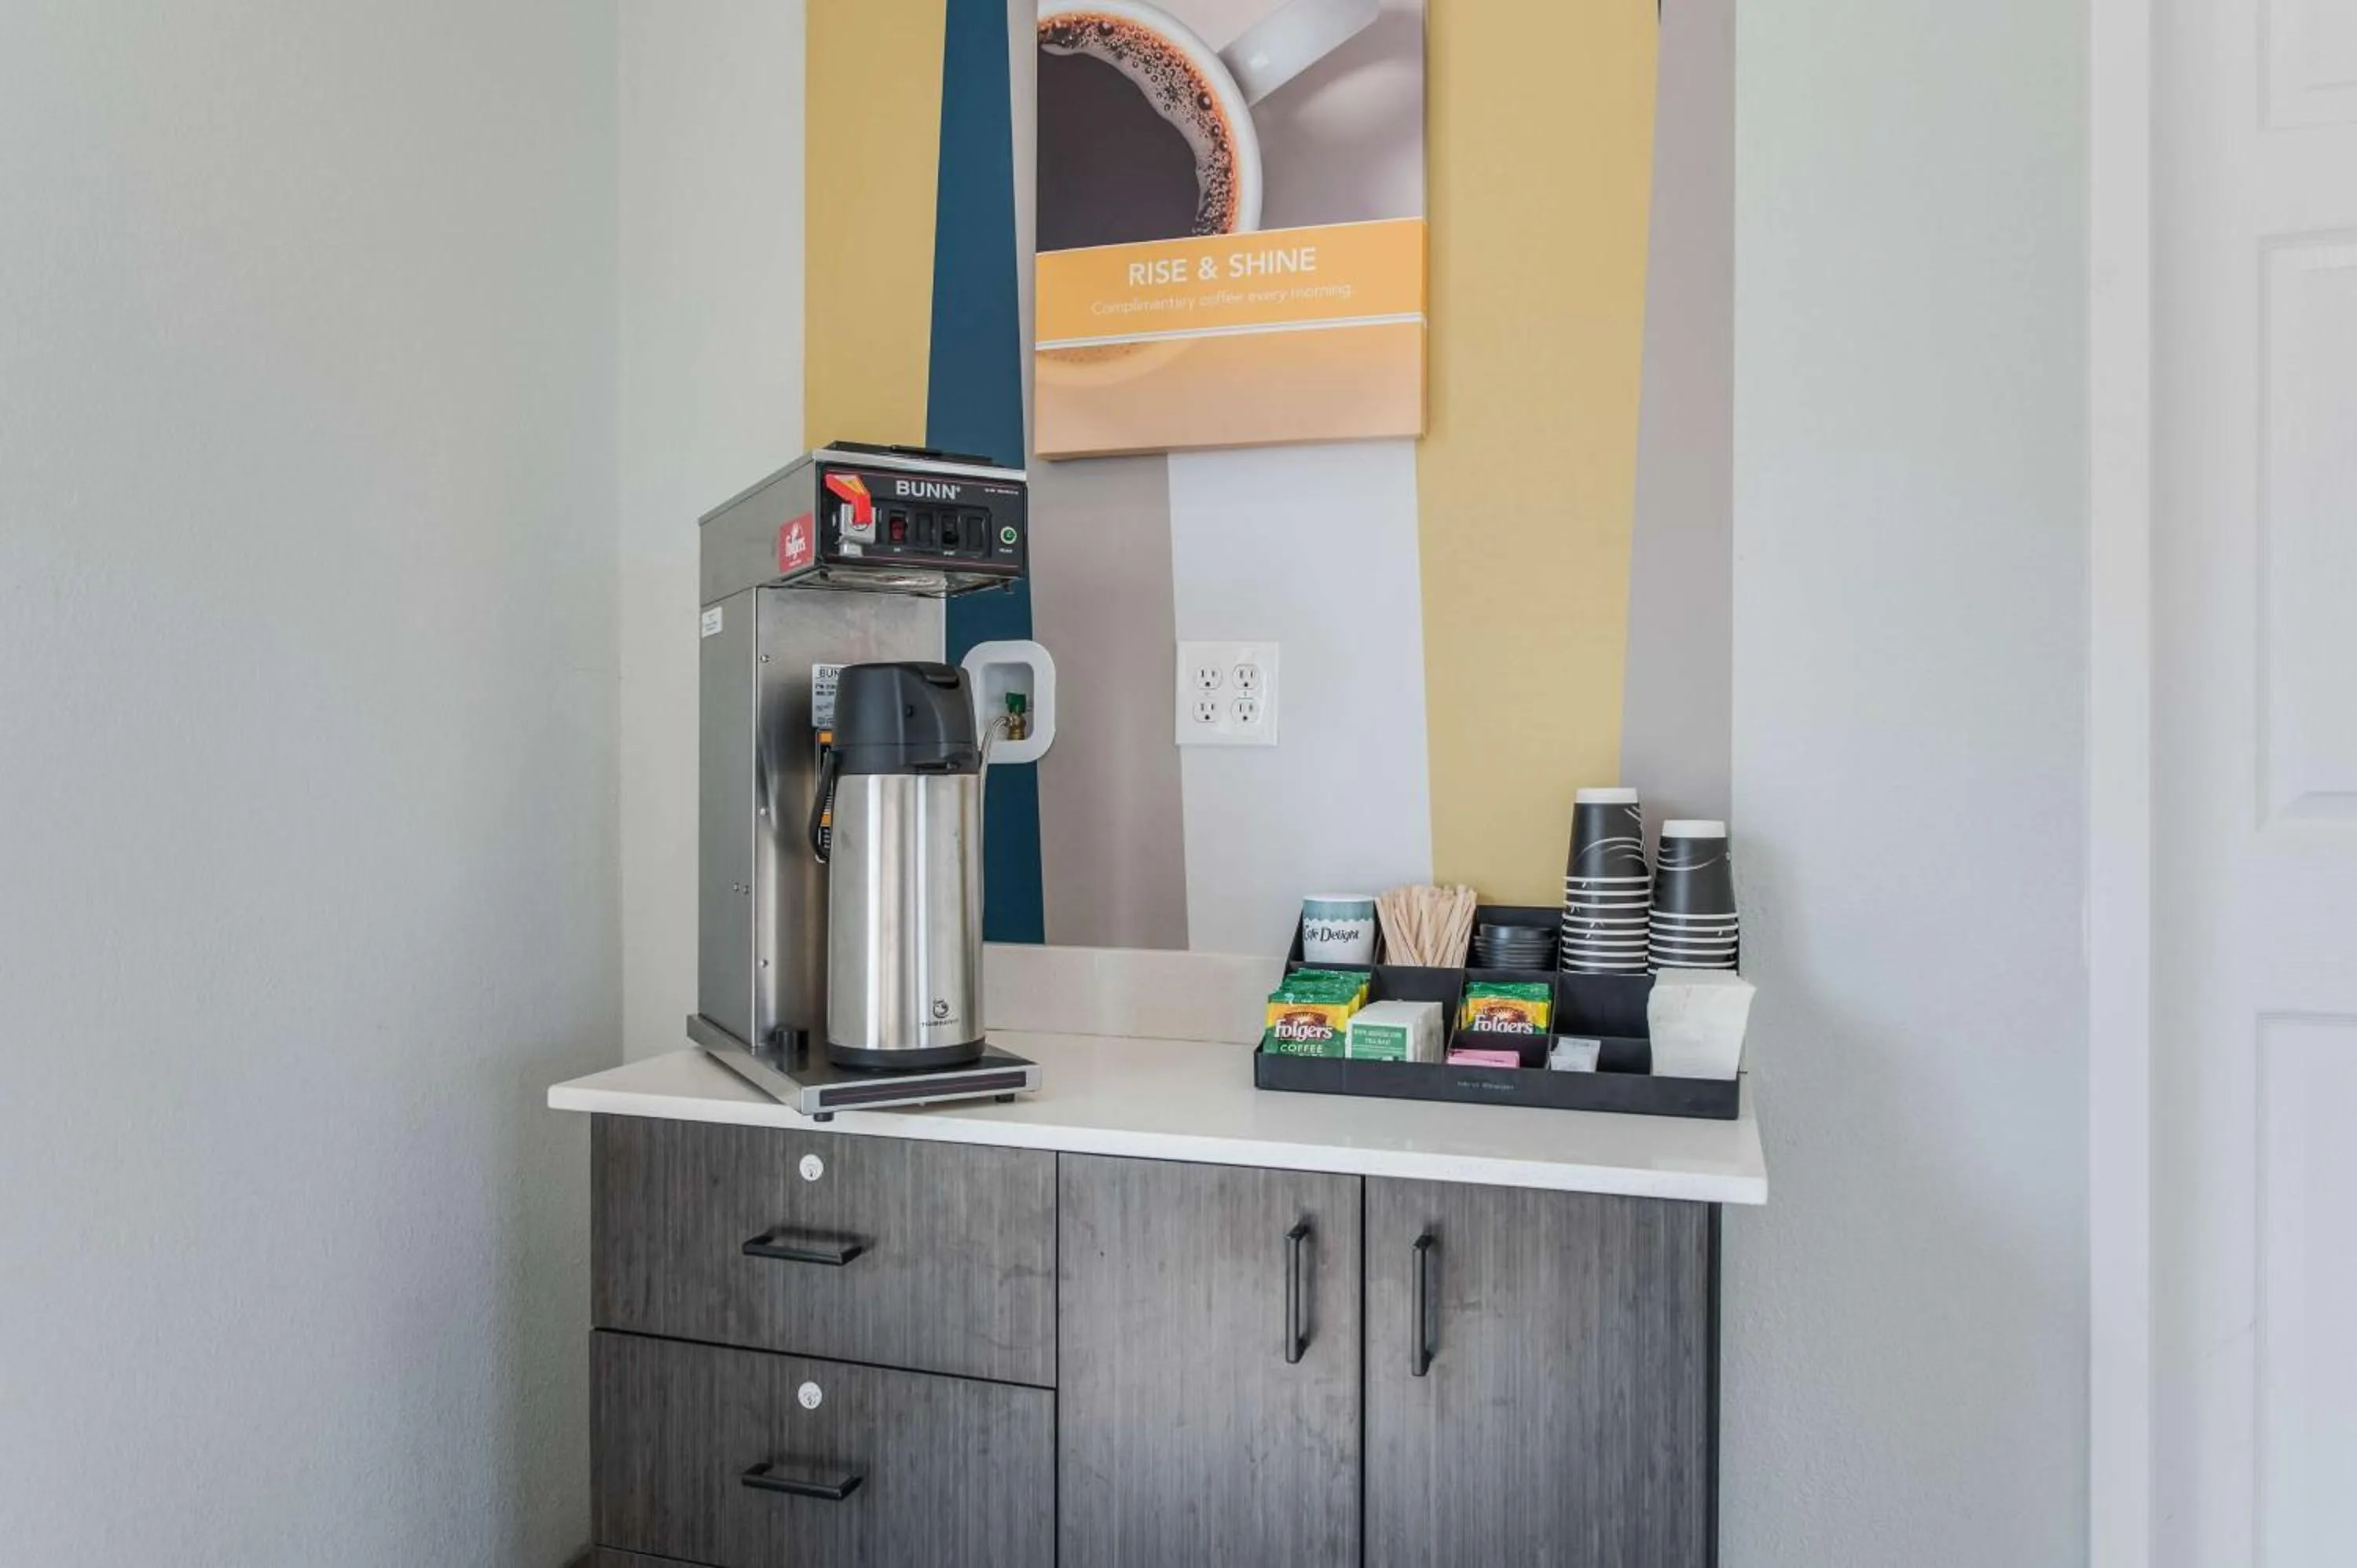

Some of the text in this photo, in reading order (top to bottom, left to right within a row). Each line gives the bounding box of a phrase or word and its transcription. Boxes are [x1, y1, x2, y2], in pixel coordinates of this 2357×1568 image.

[1129, 246, 1317, 287] RISE & SHINE
[1199, 289, 1244, 306] coffee
[1248, 289, 1288, 304] every
[896, 480, 957, 500] BUNN
[819, 669, 841, 678] BUN
[1320, 927, 1359, 943] Delight
[1274, 1019, 1333, 1042] Folgers
[1280, 1044, 1324, 1053] COFFEE
